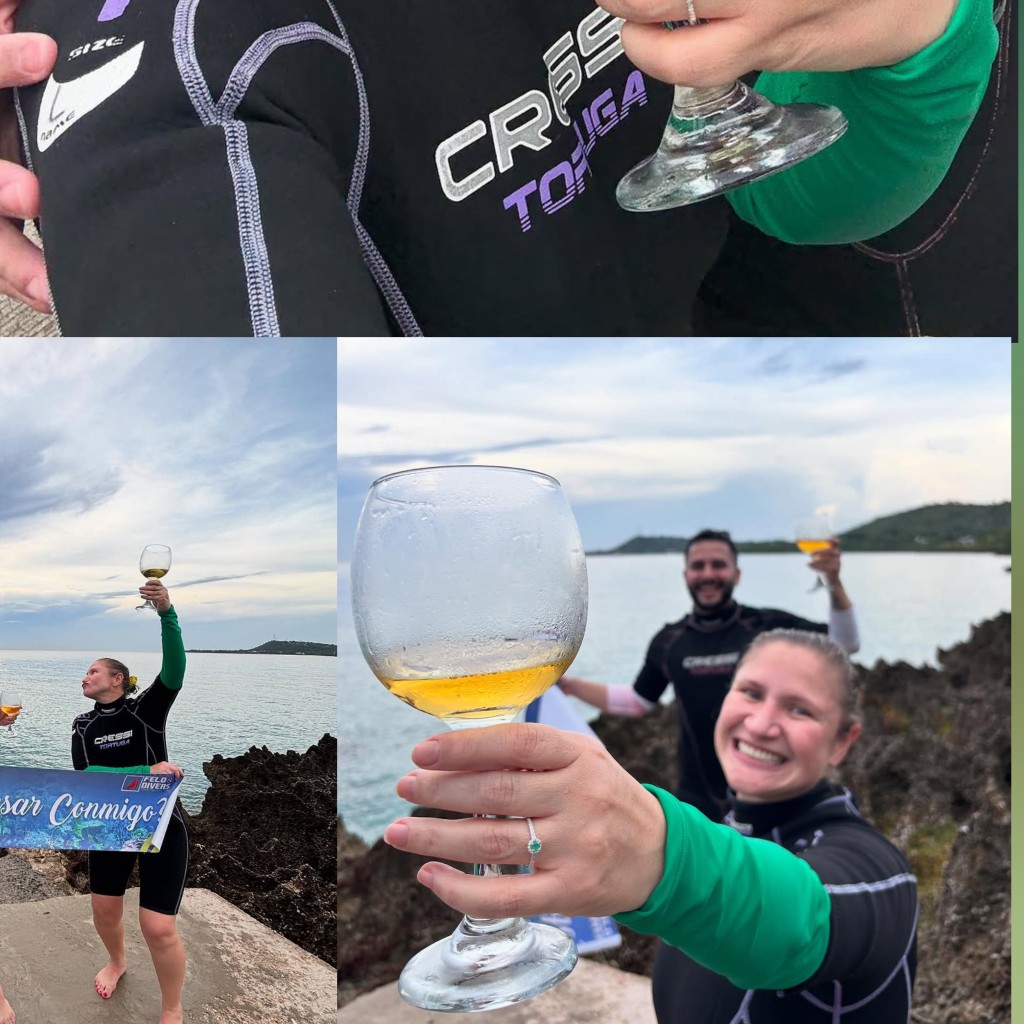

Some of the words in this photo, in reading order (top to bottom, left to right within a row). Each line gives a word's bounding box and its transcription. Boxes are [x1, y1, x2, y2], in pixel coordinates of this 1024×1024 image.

[68, 35, 125, 62] SIZE
[94, 729, 133, 744] CRESSI
[99, 739, 131, 749] TORTUGA
